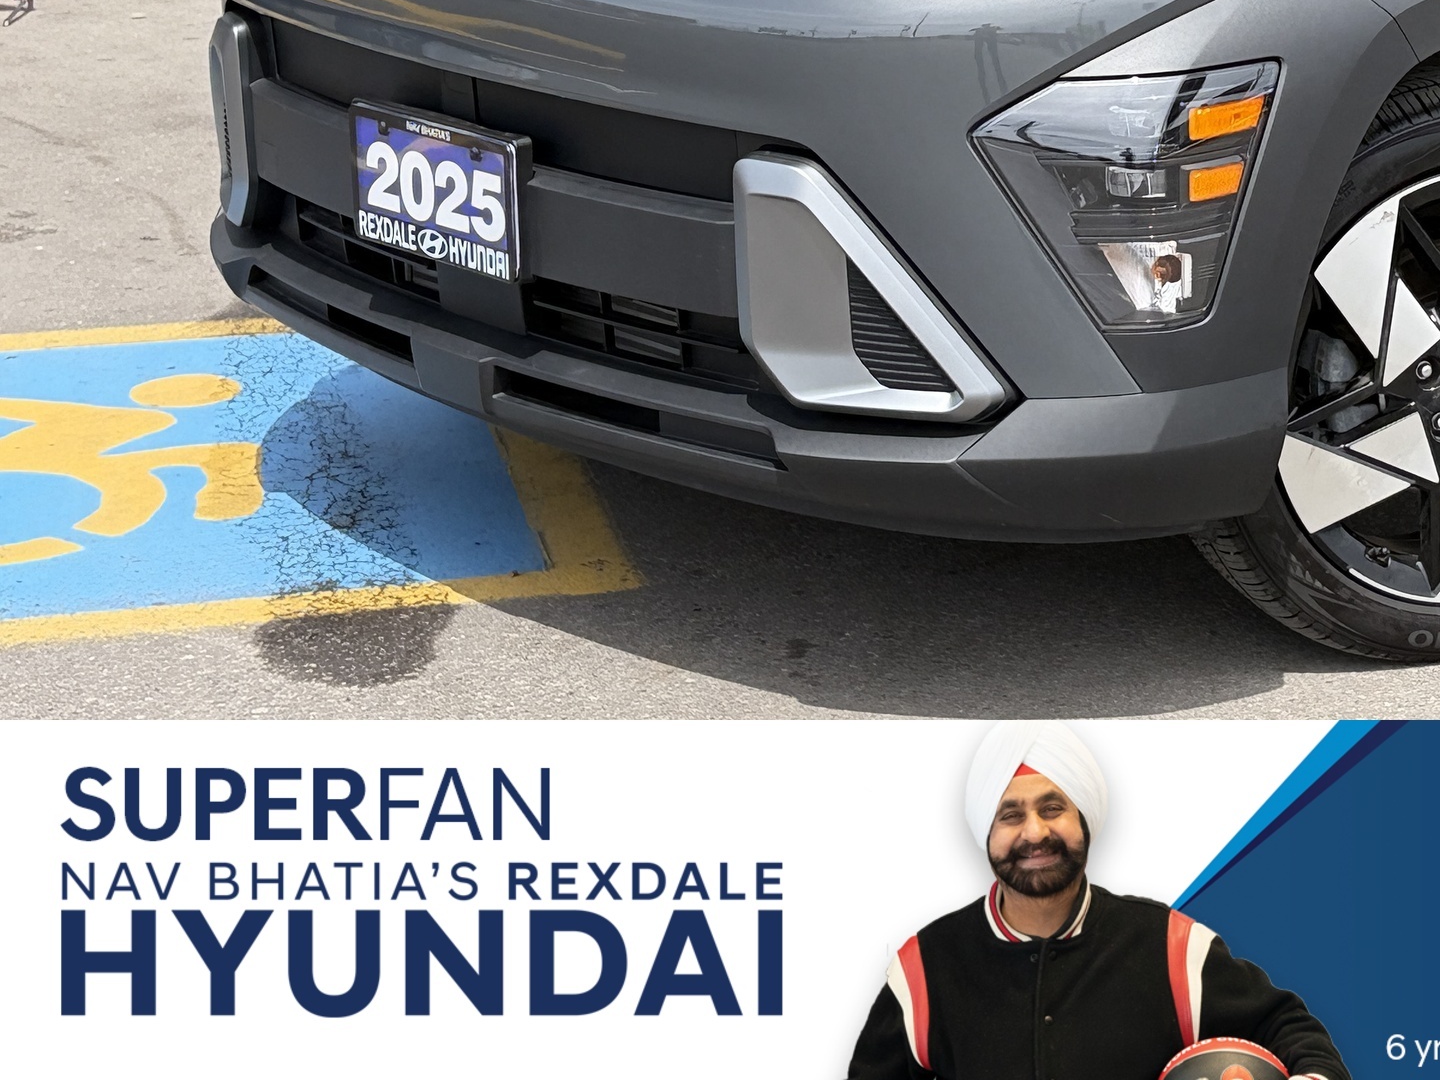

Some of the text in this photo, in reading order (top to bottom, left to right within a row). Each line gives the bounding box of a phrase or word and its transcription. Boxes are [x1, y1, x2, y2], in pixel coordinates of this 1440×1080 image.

[366, 141, 506, 242] 2025
[359, 210, 510, 280] REXDALE HYUNDAI
